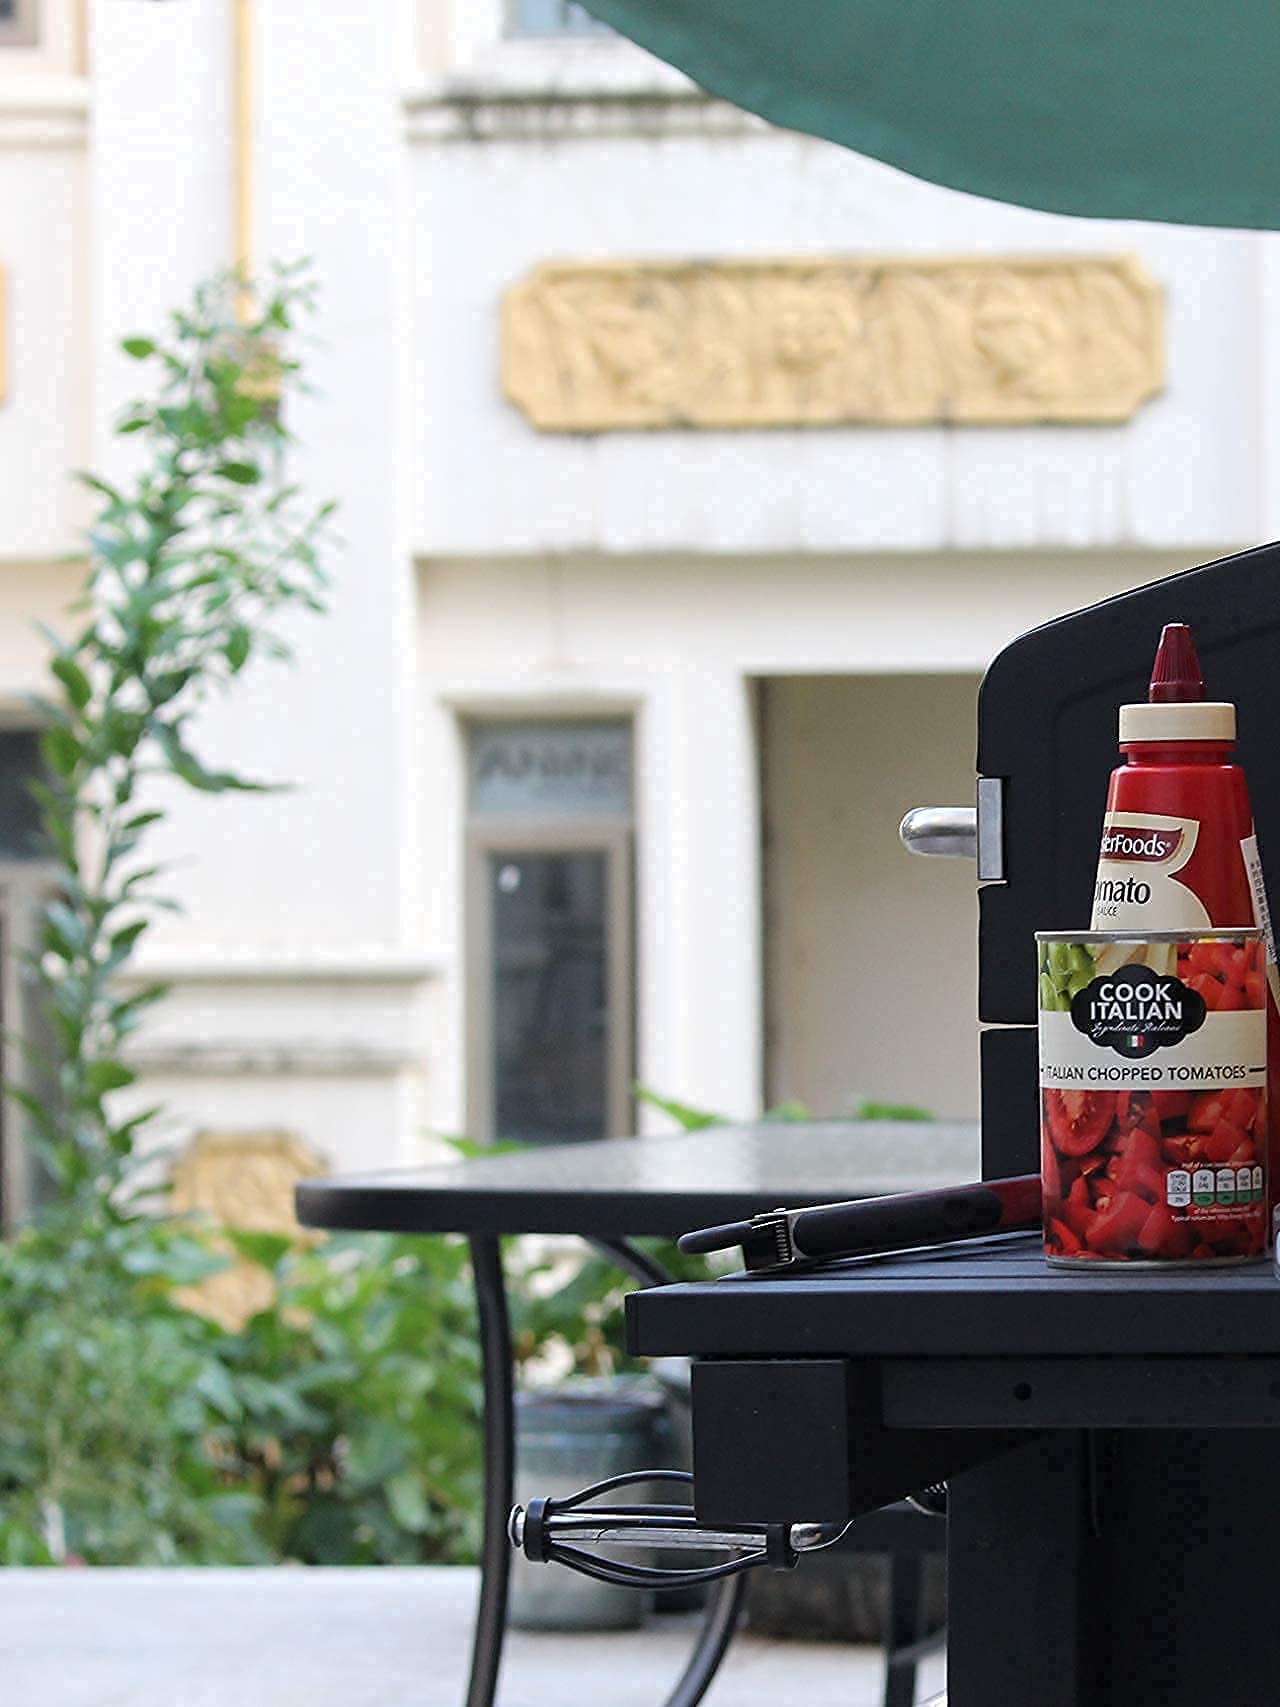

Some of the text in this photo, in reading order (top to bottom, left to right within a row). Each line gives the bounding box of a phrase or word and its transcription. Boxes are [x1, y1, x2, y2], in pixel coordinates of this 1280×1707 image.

[1099, 983, 1172, 1002] COOK
[1090, 1001, 1183, 1020] ITALIAN
[1087, 1066, 1163, 1081] CHOPPED
[1167, 1065, 1246, 1080] TOMATOES
